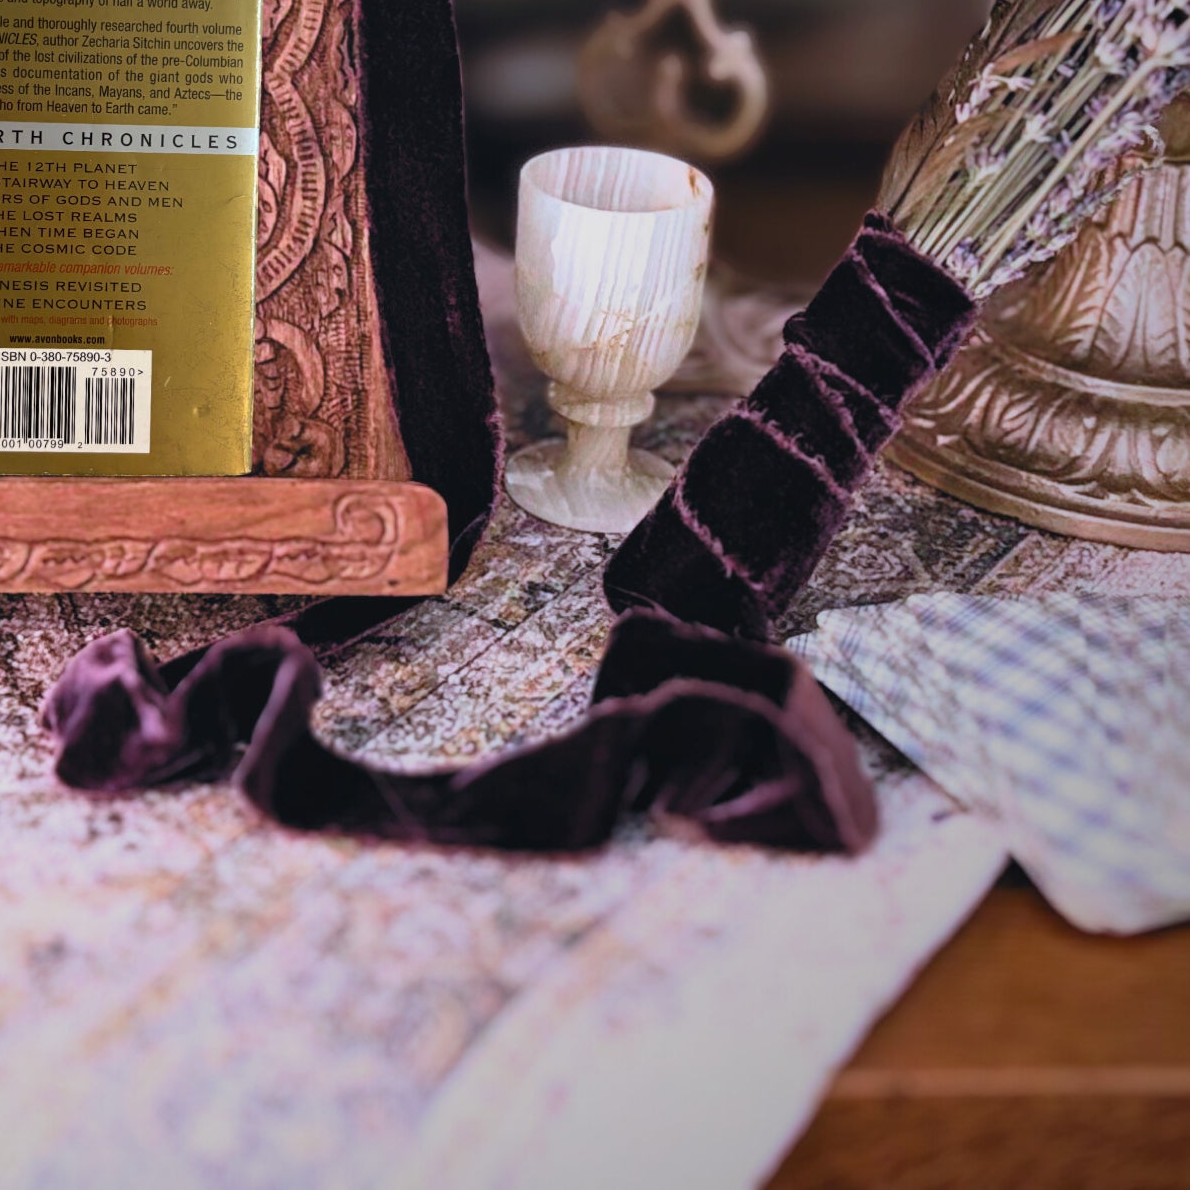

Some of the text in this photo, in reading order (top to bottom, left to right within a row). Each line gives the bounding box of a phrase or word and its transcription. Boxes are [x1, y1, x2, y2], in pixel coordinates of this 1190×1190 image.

[181, 0, 213, 12] away.
[12, 16, 34, 29] and
[37, 17, 97, 34] thoroughly
[100, 20, 163, 33] researched
[165, 20, 199, 34] fourth
[201, 22, 242, 36] volume
[42, 34, 80, 47] author
[81, 34, 130, 49] Zecharia
[132, 36, 171, 50] Sitchin
[173, 40, 224, 51] uncovers
[12, 49, 31, 62] the
[34, 49, 55, 63] lost
[58, 50, 123, 65] civilizations
[161, 54, 244, 68] pre-Columbian
[12, 66, 102, 81] documentation
[124, 69, 144, 82] the
[149, 71, 180, 85] giant
[184, 71, 213, 86] gods
[218, 72, 243, 85] who
[32, 83, 51, 96] the
[55, 83, 94, 98] Incans,
[99, 85, 145, 100] Mayans,
[149, 86, 170, 99] and
[16, 98, 43, 112] from
[46, 99, 88, 113] Heaven
[105, 101, 134, 115] Earth
[62, 131, 237, 149] CHRONICLES
[27, 161, 66, 173] 12TH
[73, 162, 137, 175] PLANET
[77, 179, 99, 190] TO
[105, 179, 169, 191] HEAVEN
[28, 194, 50, 205] OF
[56, 195, 101, 206] GODS
[106, 196, 142, 207] AND
[148, 197, 183, 208] MEN
[22, 210, 65, 222] LOST
[71, 211, 137, 223] REALMS
[37, 227, 77, 238] TIME
[83, 228, 139, 239] BEGAN
[20, 243, 85, 255] COSMIC
[91, 244, 137, 256] CODE
[58, 263, 122, 276] companion
[123, 264, 174, 276] volumes:
[55, 281, 142, 293] REVISITED
[32, 298, 146, 311] ENCOUNTERS
[1, 315, 18, 324] with
[21, 315, 43, 325] maps,
[49, 315, 86, 326] diagrams
[90, 316, 104, 325] and
[9, 334, 105, 345] www.avonbooks.com
[29, 351, 111, 363] 0-380-75890-3
